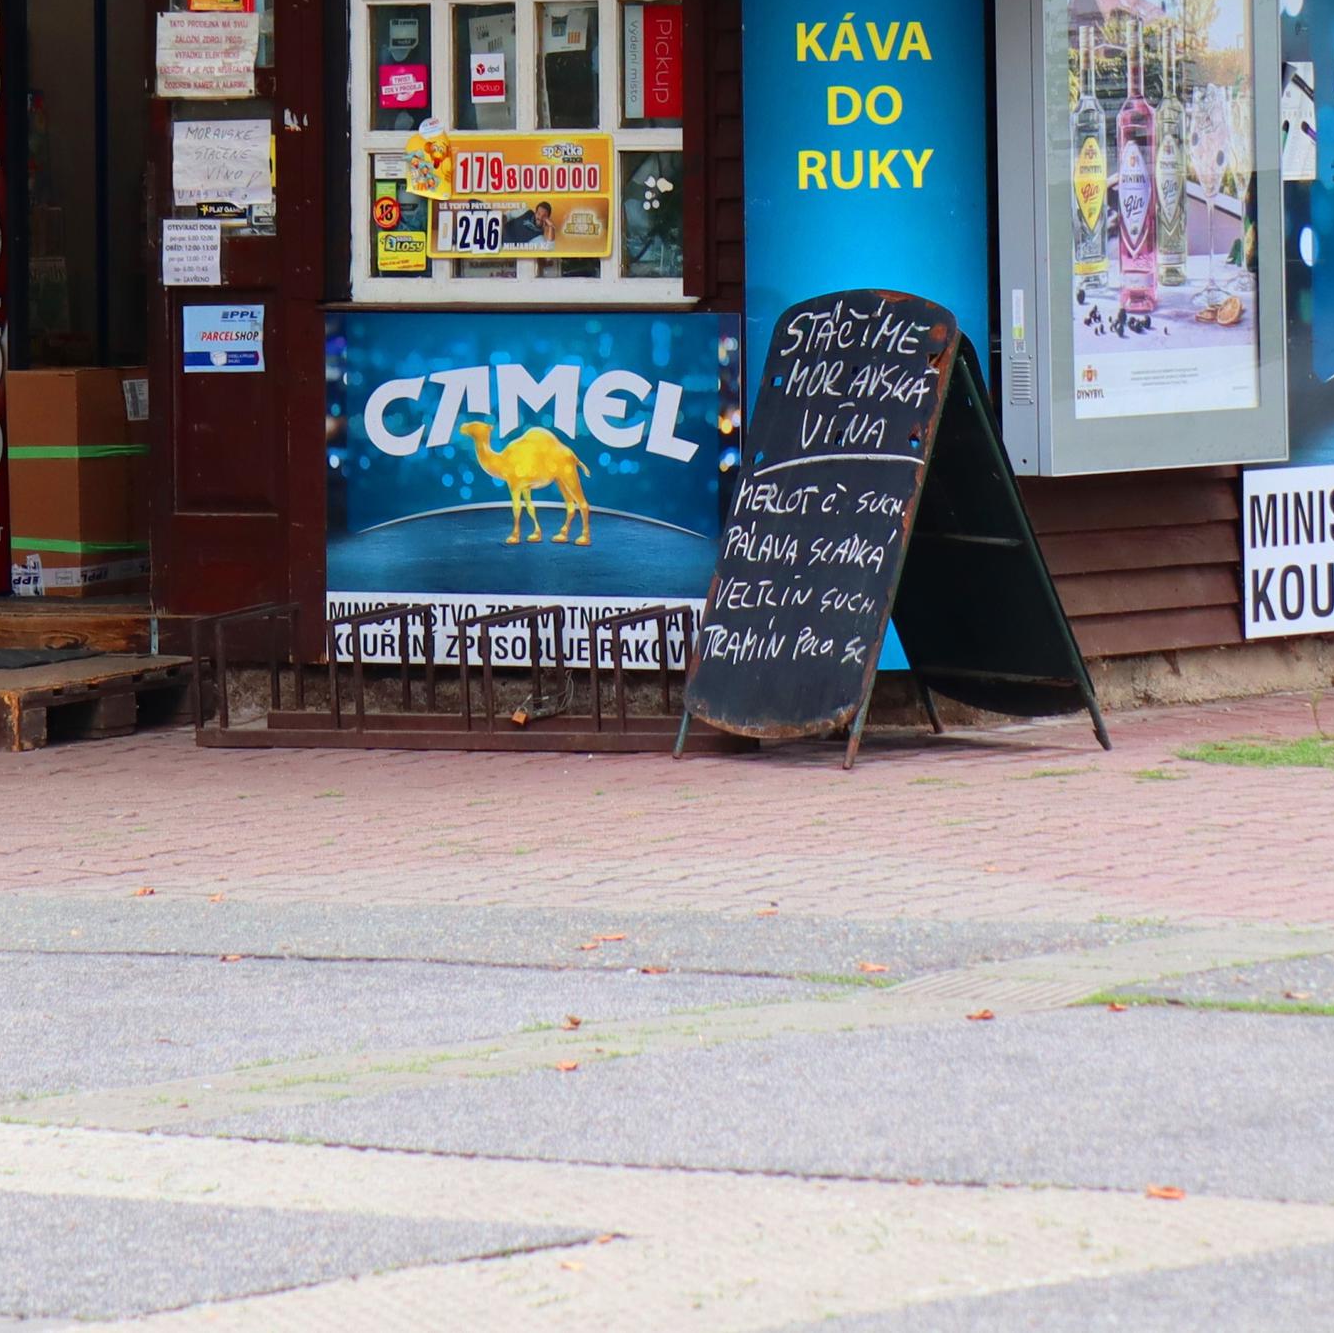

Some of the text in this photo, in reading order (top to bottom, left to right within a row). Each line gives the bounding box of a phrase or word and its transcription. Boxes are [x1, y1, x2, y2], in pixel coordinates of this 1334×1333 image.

[796, 12, 933, 62] KÁVA
[487, 65, 500, 74] dpd
[652, 19, 673, 104] Pickup
[476, 84, 500, 92] Pickup
[827, 85, 903, 126] DO
[542, 143, 583, 158] sportka
[798, 148, 934, 190] RUKY
[1123, 194, 1145, 216] Gin
[397, 241, 424, 252] LOSY
[459, 216, 500, 250] 246
[230, 311, 258, 319] PPL
[201, 331, 259, 341] PARCELSHOP
[785, 359, 940, 408] MORAVSKÁ
[364, 363, 699, 463] CAMEL
[801, 402, 888, 450] VÍNA
[734, 479, 819, 516] MERLOT
[702, 615, 786, 665] TRAMÍN
